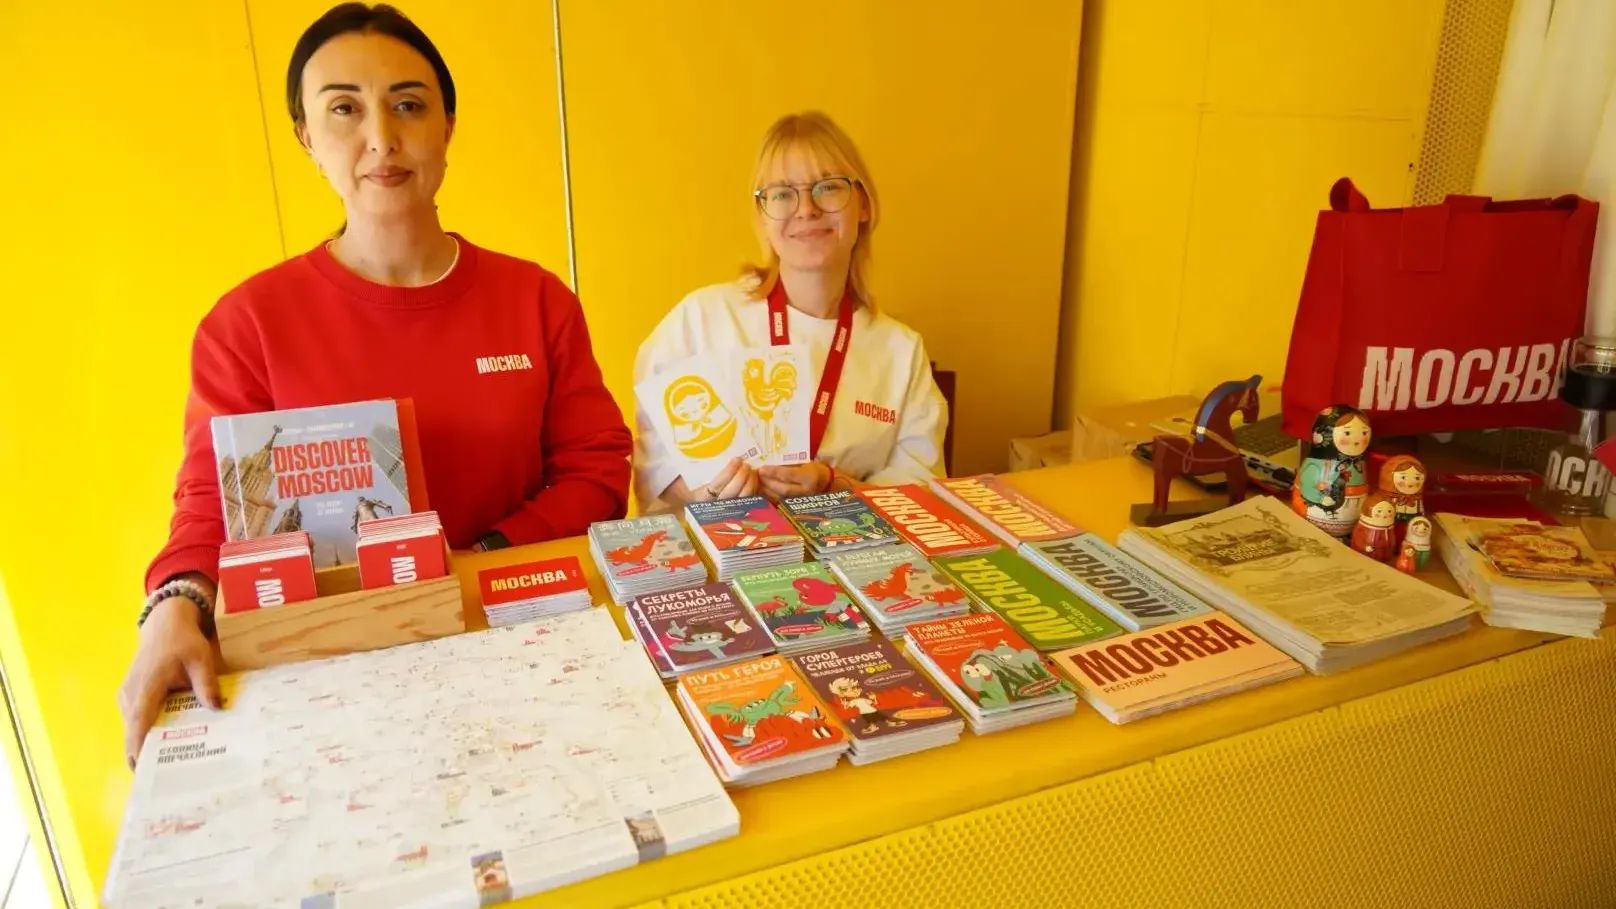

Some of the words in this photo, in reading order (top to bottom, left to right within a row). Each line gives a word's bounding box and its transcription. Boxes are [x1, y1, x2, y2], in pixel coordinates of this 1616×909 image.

[476, 354, 532, 374] МОСКВА
[854, 400, 896, 424] МОСКВА
[273, 437, 371, 473] DISCOVER
[278, 465, 373, 499] MOSCOW
[713, 496, 764, 506] ЧЕМПИОНОВ
[785, 490, 851, 503] СОЗВЕЗДИЕ
[790, 500, 840, 510] ШИФРОВ
[943, 478, 1057, 537] МОСКВА
[861, 489, 971, 548] МОСКВА
[490, 570, 568, 592] МОСКВА
[1040, 542, 1179, 618] МОСКВА
[642, 588, 707, 605] СЕКРЕТЫ
[647, 592, 731, 614] ЛУКОМОРЬЯ
[947, 558, 1085, 641] МОСКВА
[913, 624, 947, 634] ТАЙНЫ
[918, 627, 966, 641] ПЛАНЕТЫ
[800, 651, 839, 664] ГОРОД
[806, 651, 883, 671] СУПЕРГЕРОЕВ
[1069, 618, 1256, 687] МОСКВА
[686, 671, 730, 686] ПУТЬ
[733, 659, 782, 676] ГЕРОЯ
[1103, 672, 1168, 694] РЕСТОРАНЫ
